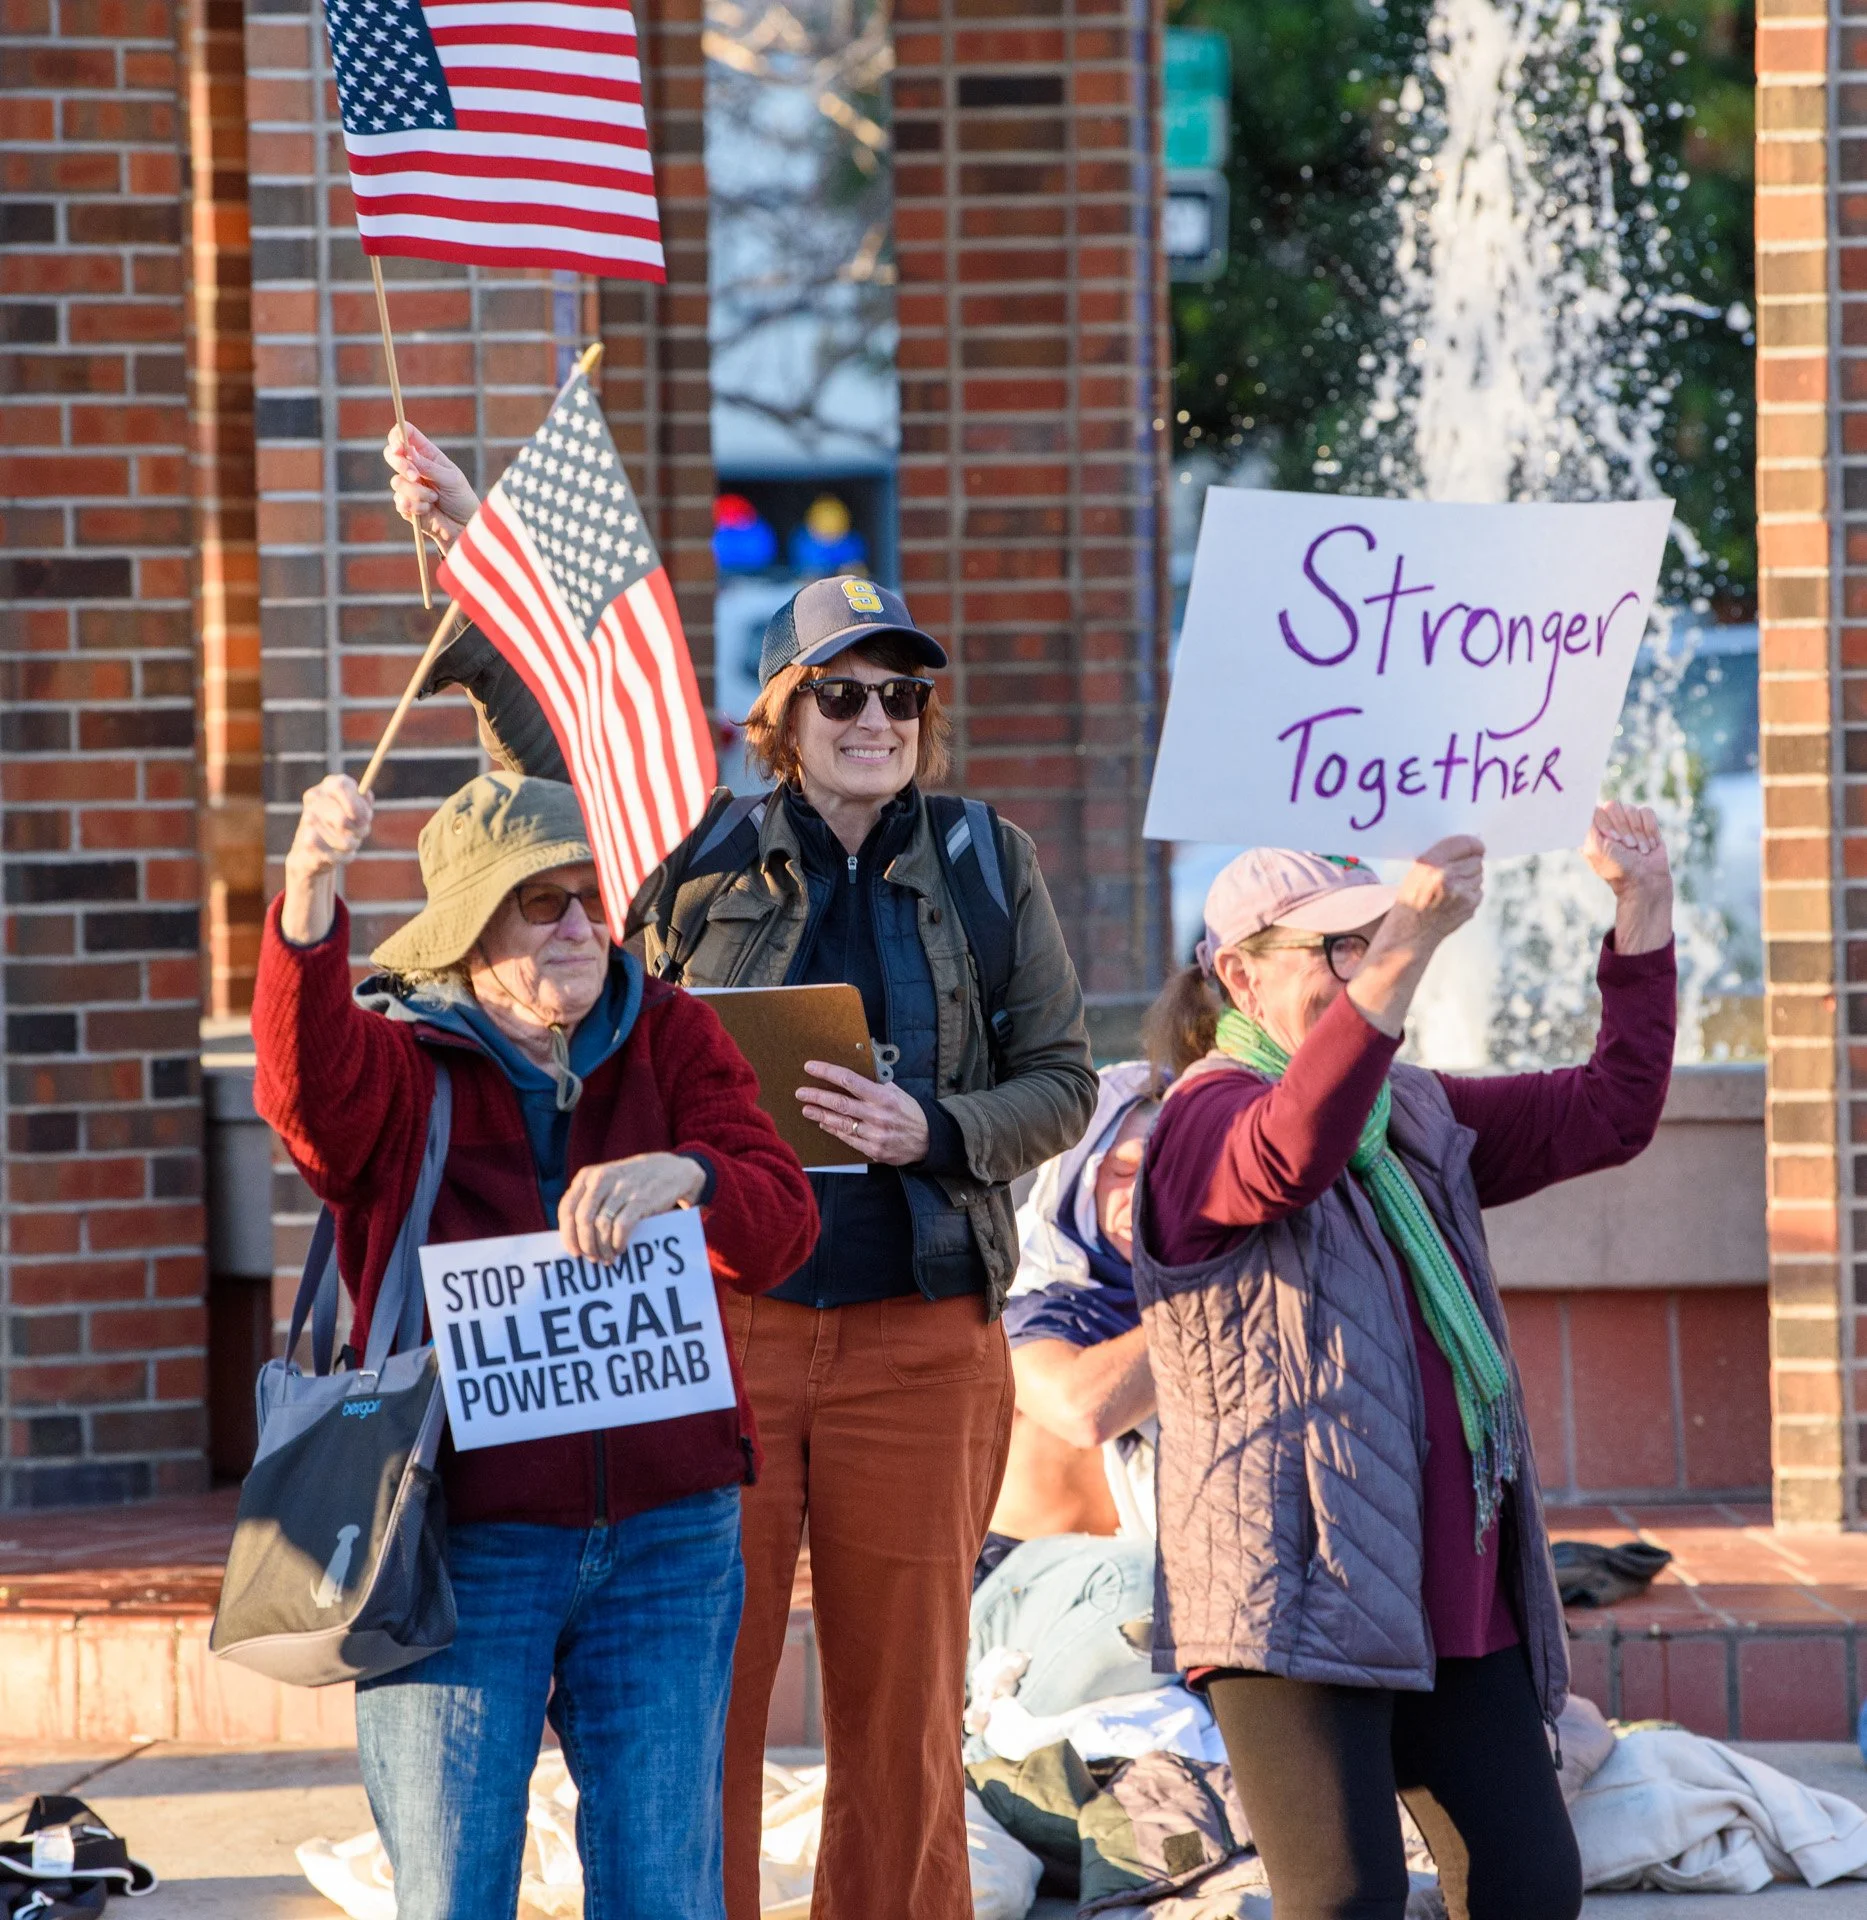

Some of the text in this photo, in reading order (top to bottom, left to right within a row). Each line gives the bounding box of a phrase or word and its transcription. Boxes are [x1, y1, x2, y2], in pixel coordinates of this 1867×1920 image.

[841, 579, 884, 613] S
[1278, 524, 1640, 740] Stronger
[442, 1236, 686, 1312] STOP TRUMP'S
[448, 1286, 702, 1371] ILLEGAL
[457, 1340, 710, 1421] POWER GRAB
